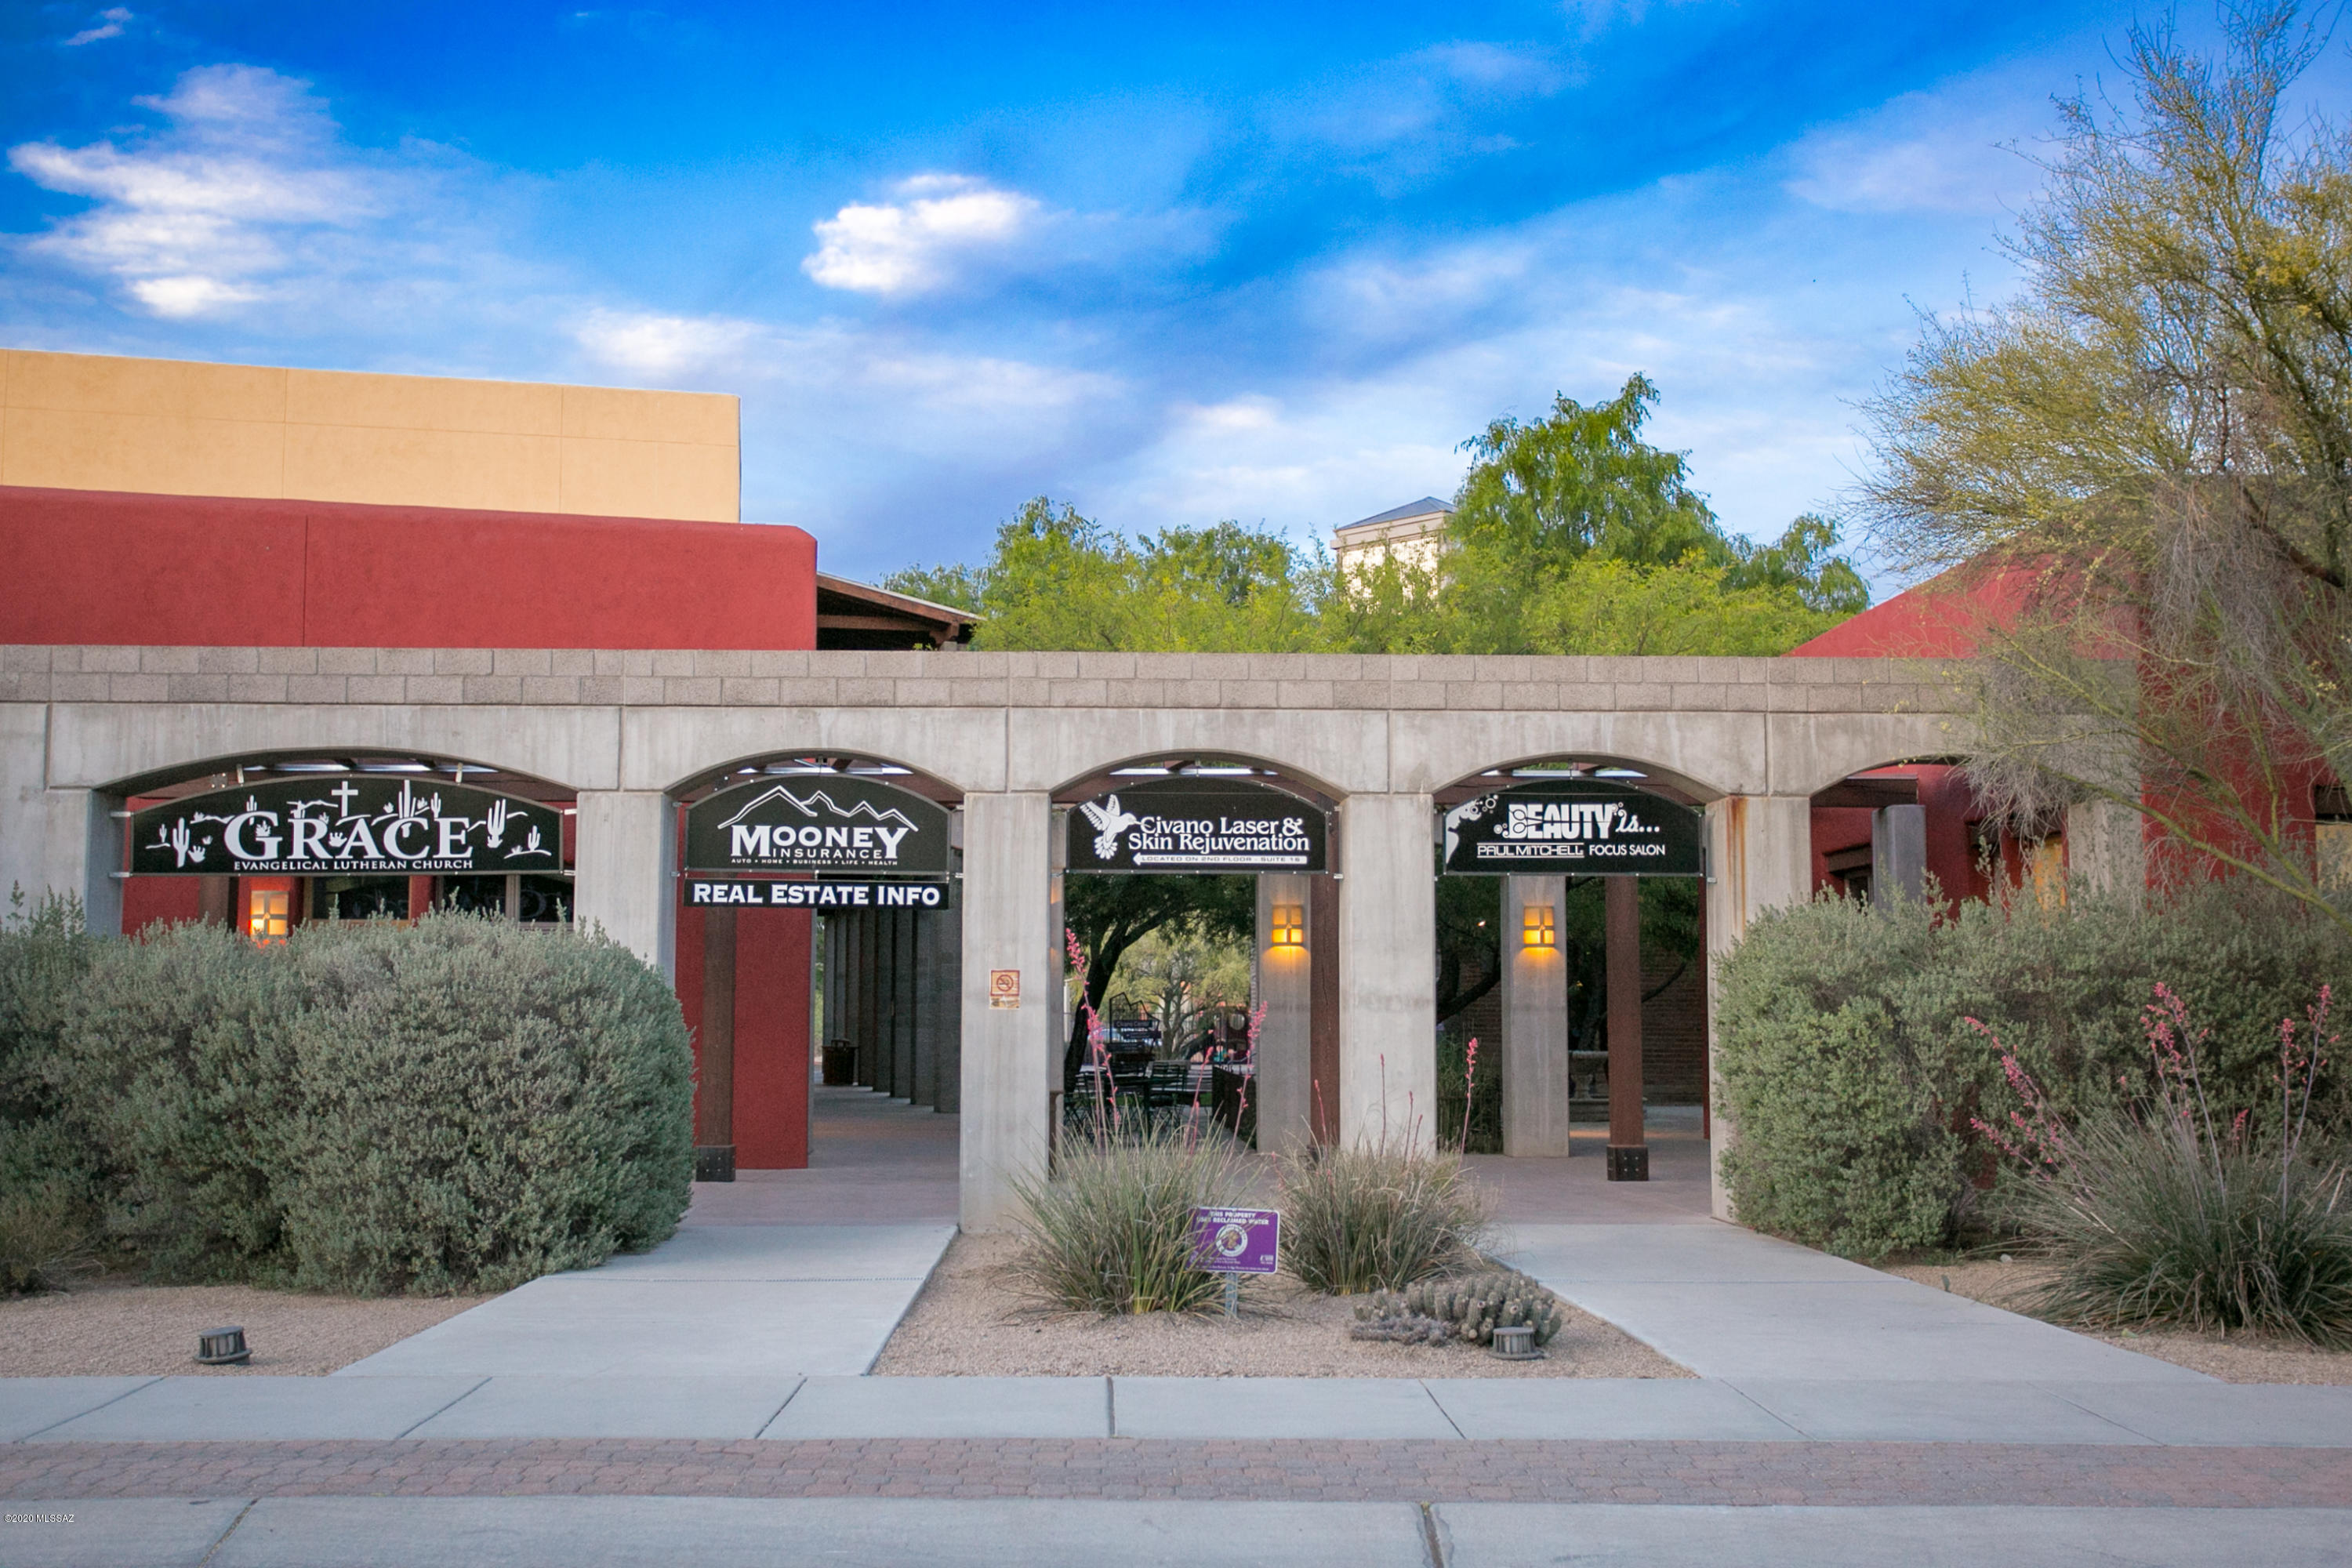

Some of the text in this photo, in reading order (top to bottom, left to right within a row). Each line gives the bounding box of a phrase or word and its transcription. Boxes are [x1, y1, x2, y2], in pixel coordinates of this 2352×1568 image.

[1140, 816, 1305, 837] Civano Laser &
[1507, 804, 1614, 839] BEAUTY
[223, 811, 473, 860] GRACE
[730, 825, 909, 859] MOONEY
[1128, 833, 1310, 855] Skin Rejuvenation
[773, 848, 883, 859] INSURANCE
[1477, 845, 1515, 856] PAUL
[1588, 844, 1627, 855] FOCUS
[1629, 844, 1666, 856] SALON
[234, 859, 473, 870] EVANGELICAL LUTHERAN CHURCH
[693, 883, 940, 906] REAL ESTATE INFO
